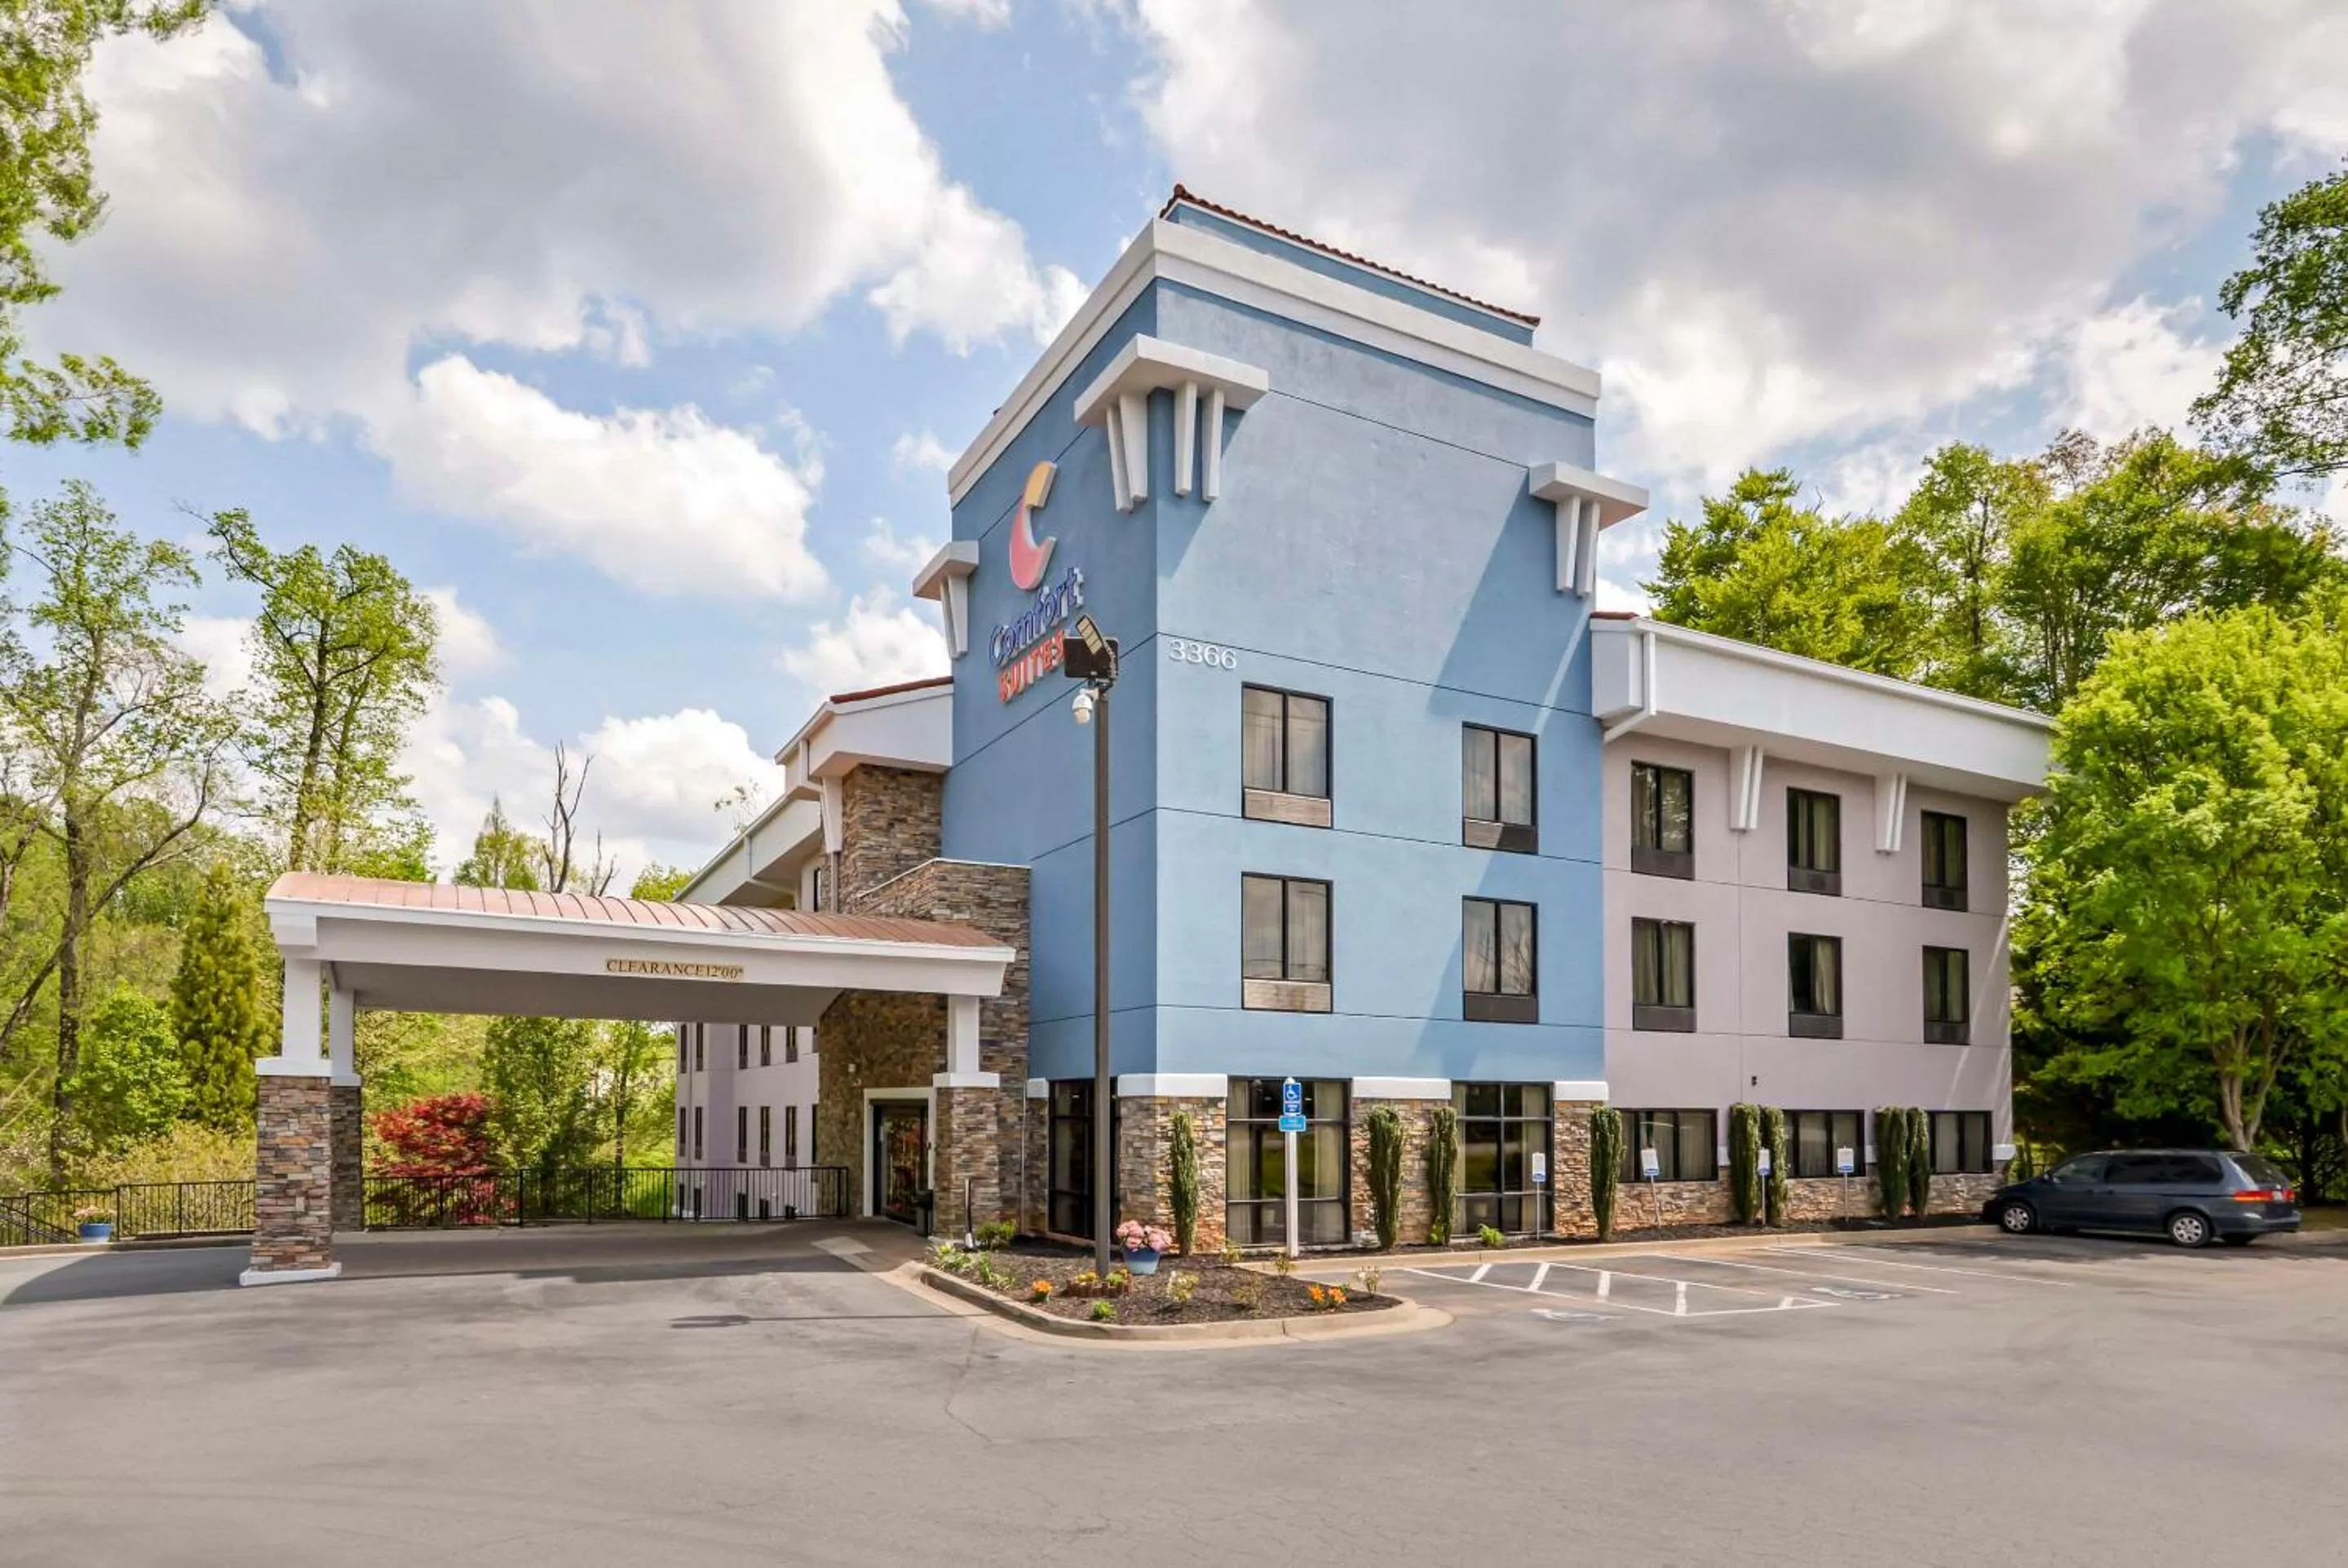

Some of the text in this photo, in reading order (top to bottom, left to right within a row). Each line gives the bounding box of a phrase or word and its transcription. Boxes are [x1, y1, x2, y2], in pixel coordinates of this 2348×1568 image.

[989, 567, 1083, 668] Comfort
[997, 627, 1065, 704] SUITES
[1169, 639, 1237, 669] 3366
[606, 959, 705, 977] CLEARANCE
